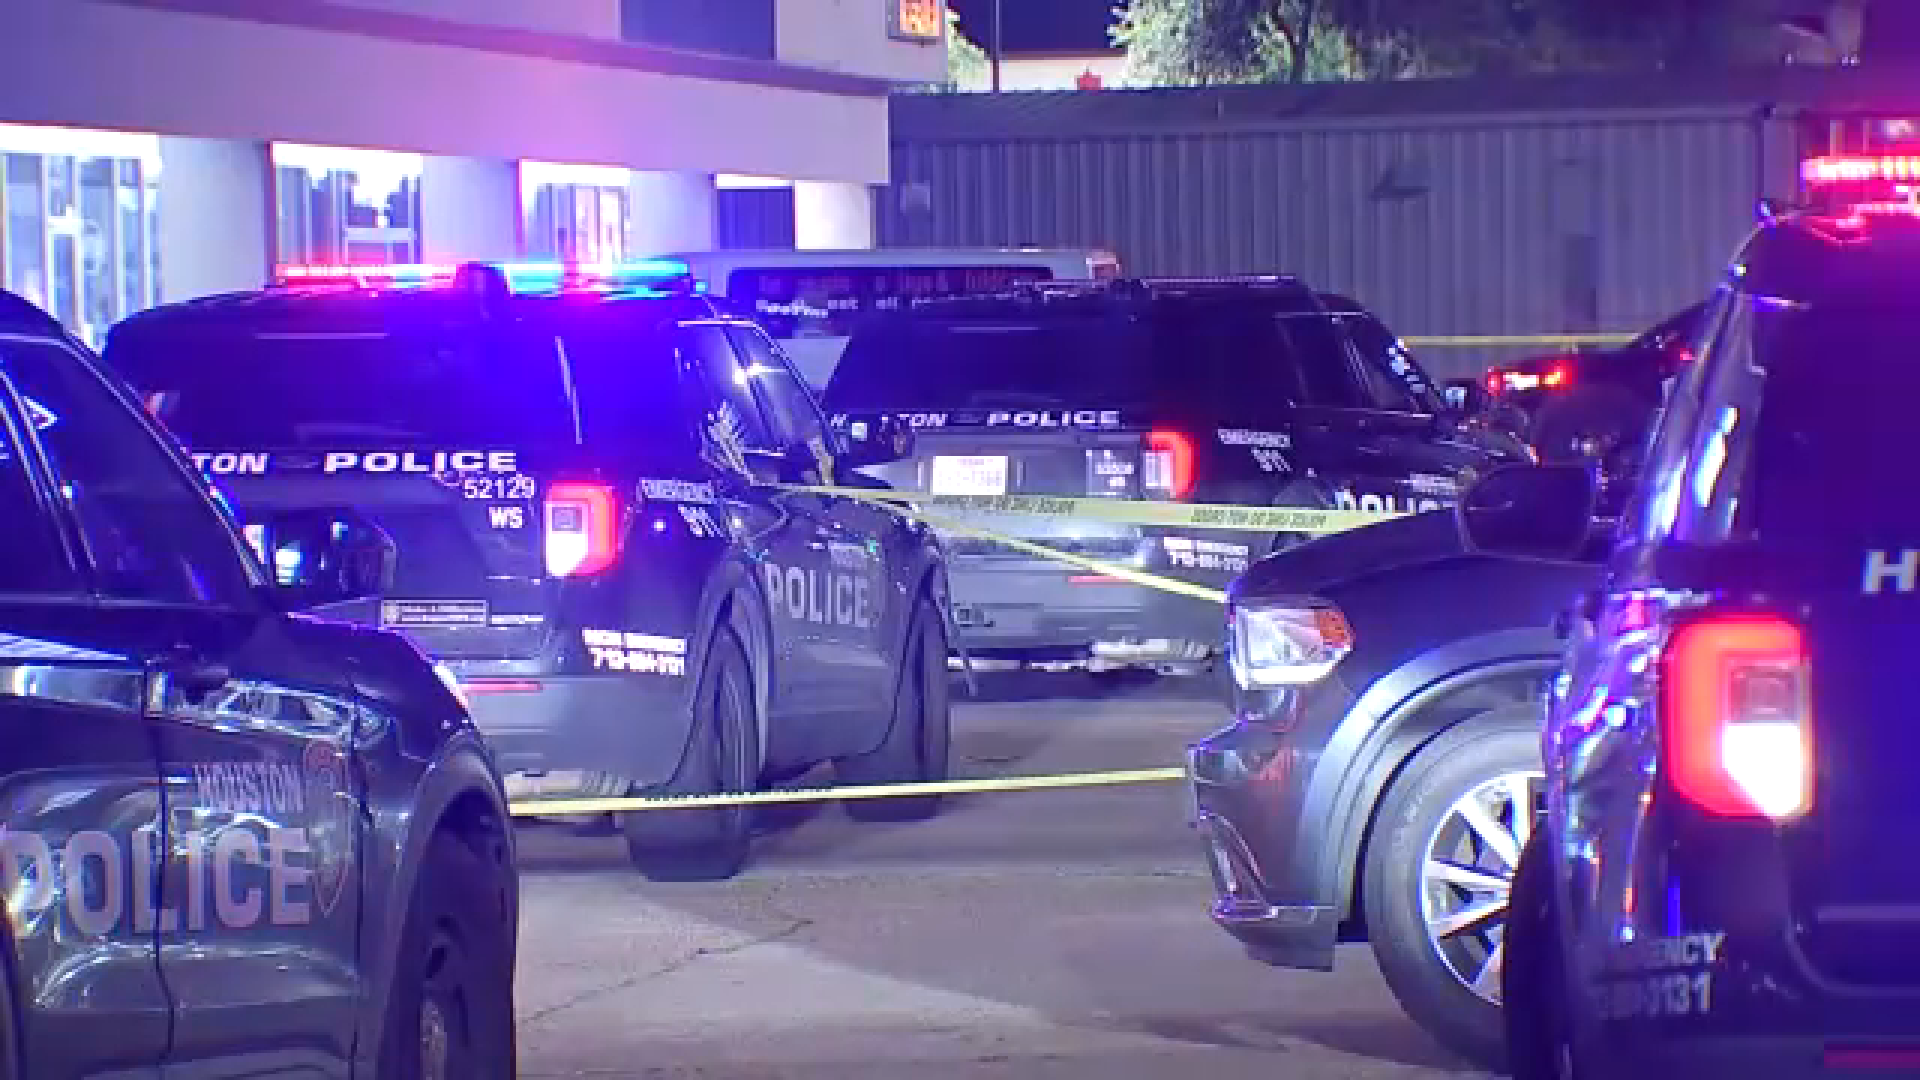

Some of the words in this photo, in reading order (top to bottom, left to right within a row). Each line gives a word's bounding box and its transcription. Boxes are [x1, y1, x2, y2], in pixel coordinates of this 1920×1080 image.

[986, 411, 1119, 427] POLICE
[323, 451, 517, 472] POLICE
[462, 476, 536, 499] 52129
[488, 506, 524, 528] WS
[764, 562, 870, 628] POLICE
[193, 762, 304, 813] HOUSTON
[0, 828, 311, 940] POLICE
